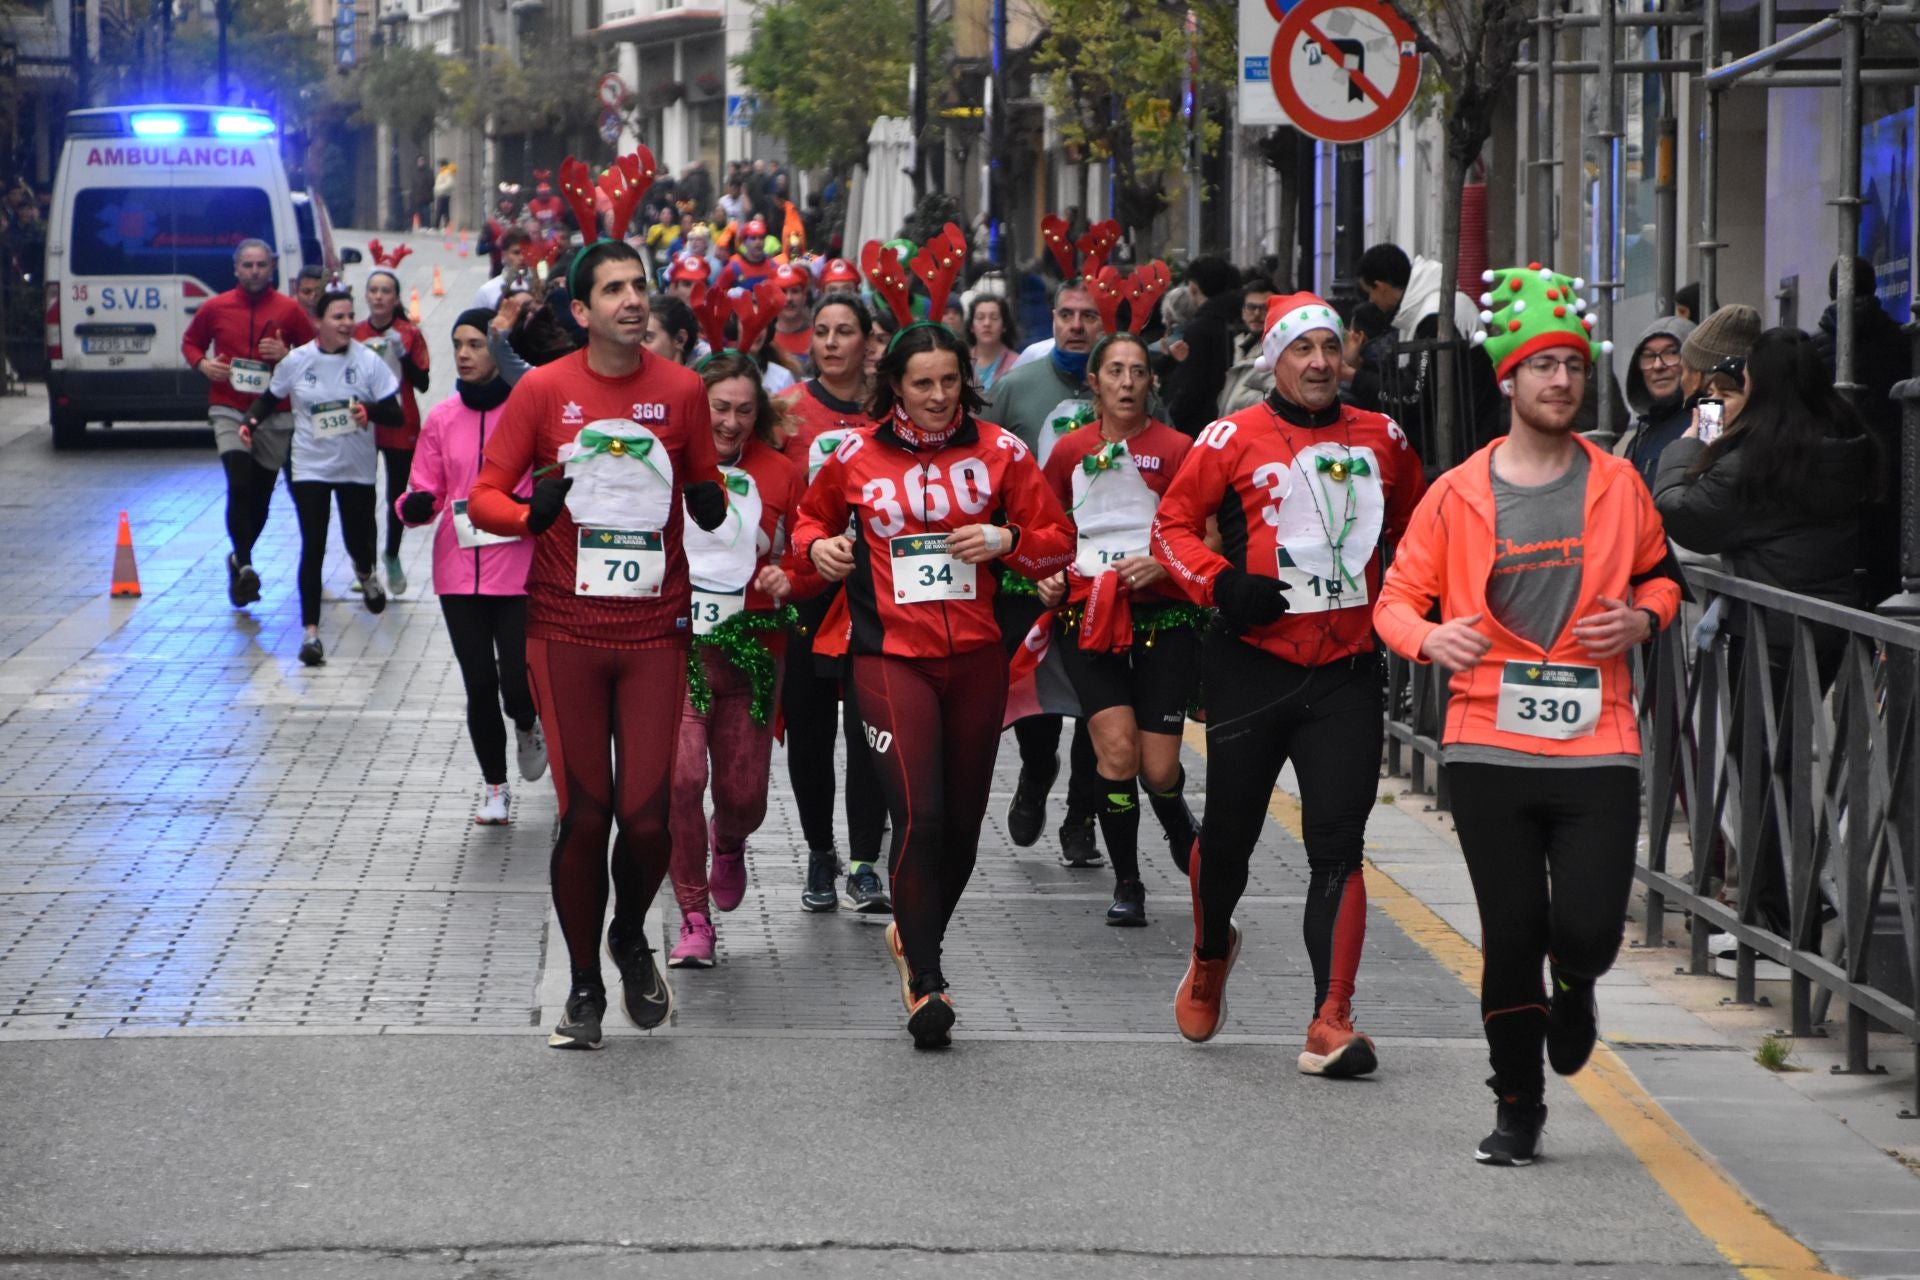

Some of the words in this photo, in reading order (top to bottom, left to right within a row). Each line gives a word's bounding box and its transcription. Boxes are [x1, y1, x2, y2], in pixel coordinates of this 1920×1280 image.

[340, 0, 353, 62] ICA
[86, 147, 256, 167] AMBULANCIA
[72, 284, 88, 301] 35
[101, 287, 167, 310] S.V.B.
[319, 414, 348, 430] 338
[632, 403, 665, 420] 360
[1134, 453, 1160, 470] 360
[862, 456, 992, 538] 360
[603, 559, 640, 583] 70
[917, 563, 954, 587] 34
[691, 601, 720, 623] 13
[1517, 696, 1581, 724] 330
